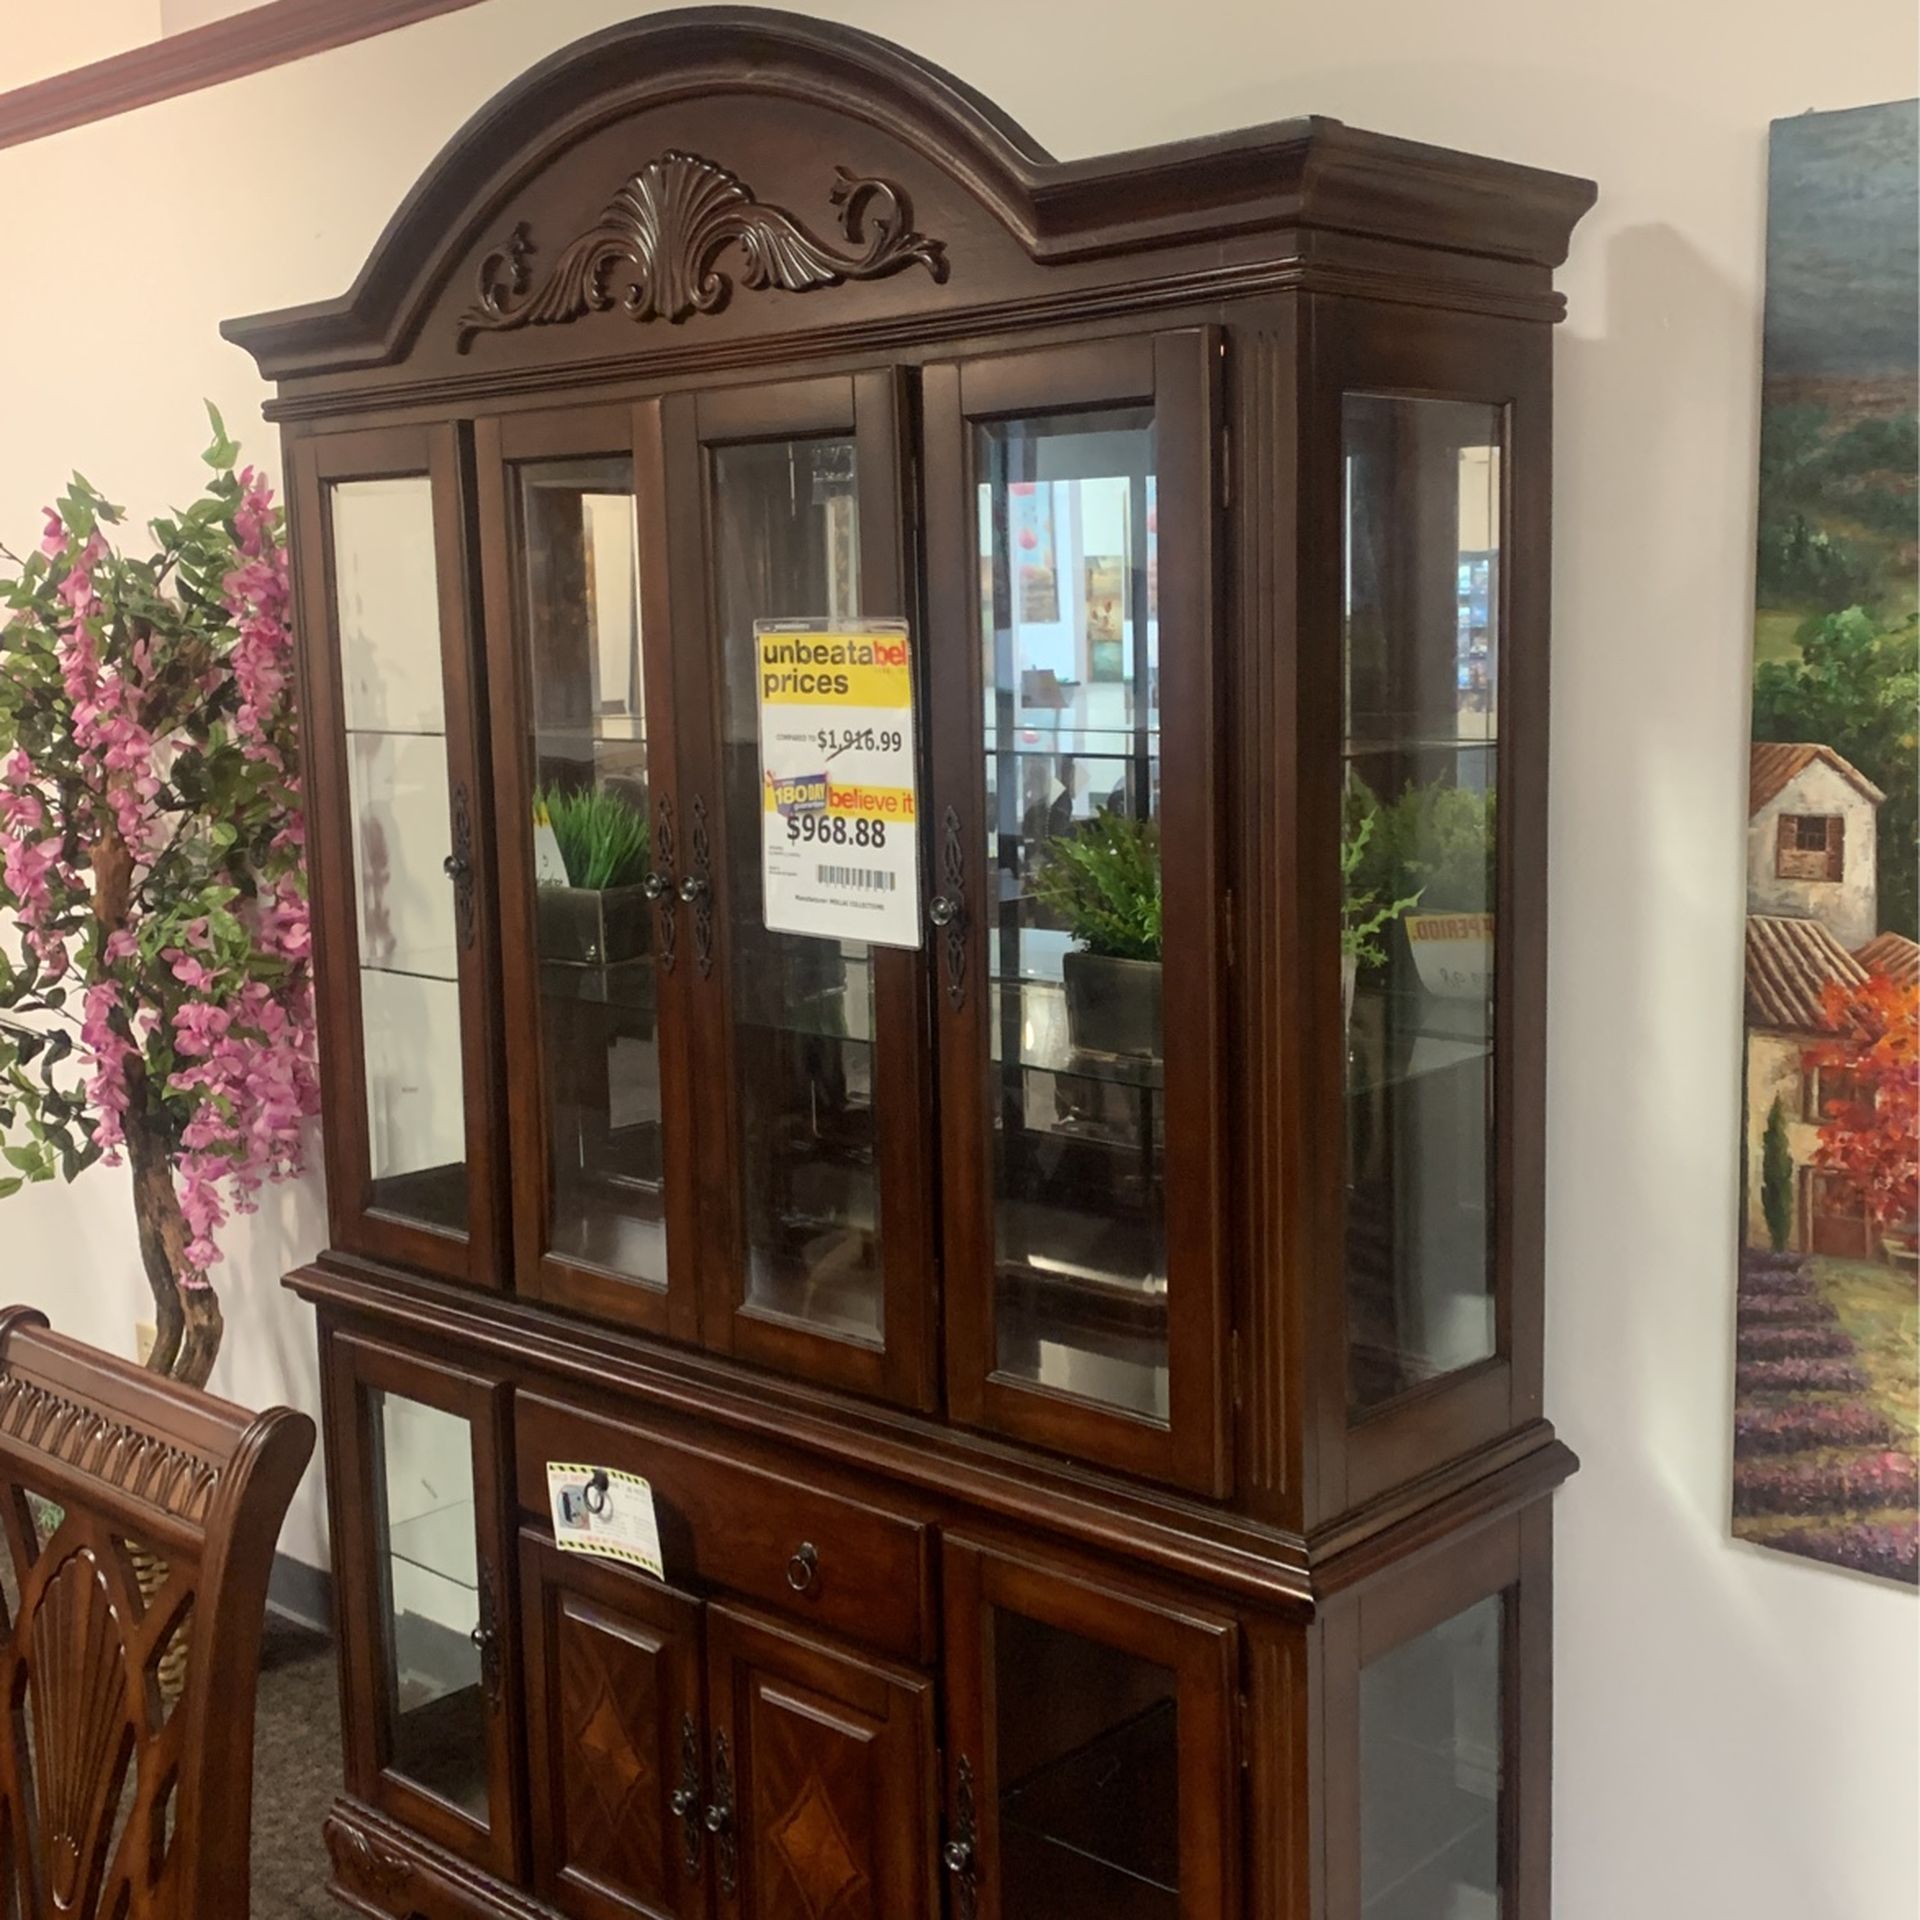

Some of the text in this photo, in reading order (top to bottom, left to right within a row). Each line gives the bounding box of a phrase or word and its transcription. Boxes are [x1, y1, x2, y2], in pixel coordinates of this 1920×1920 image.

[763, 640, 908, 666] unbeatabel
[763, 668, 849, 699] prices
[817, 728, 902, 752] $1,916.99
[775, 783, 826, 805] 180 DAY
[828, 786, 914, 814] believe it
[786, 812, 886, 848] $968.88
